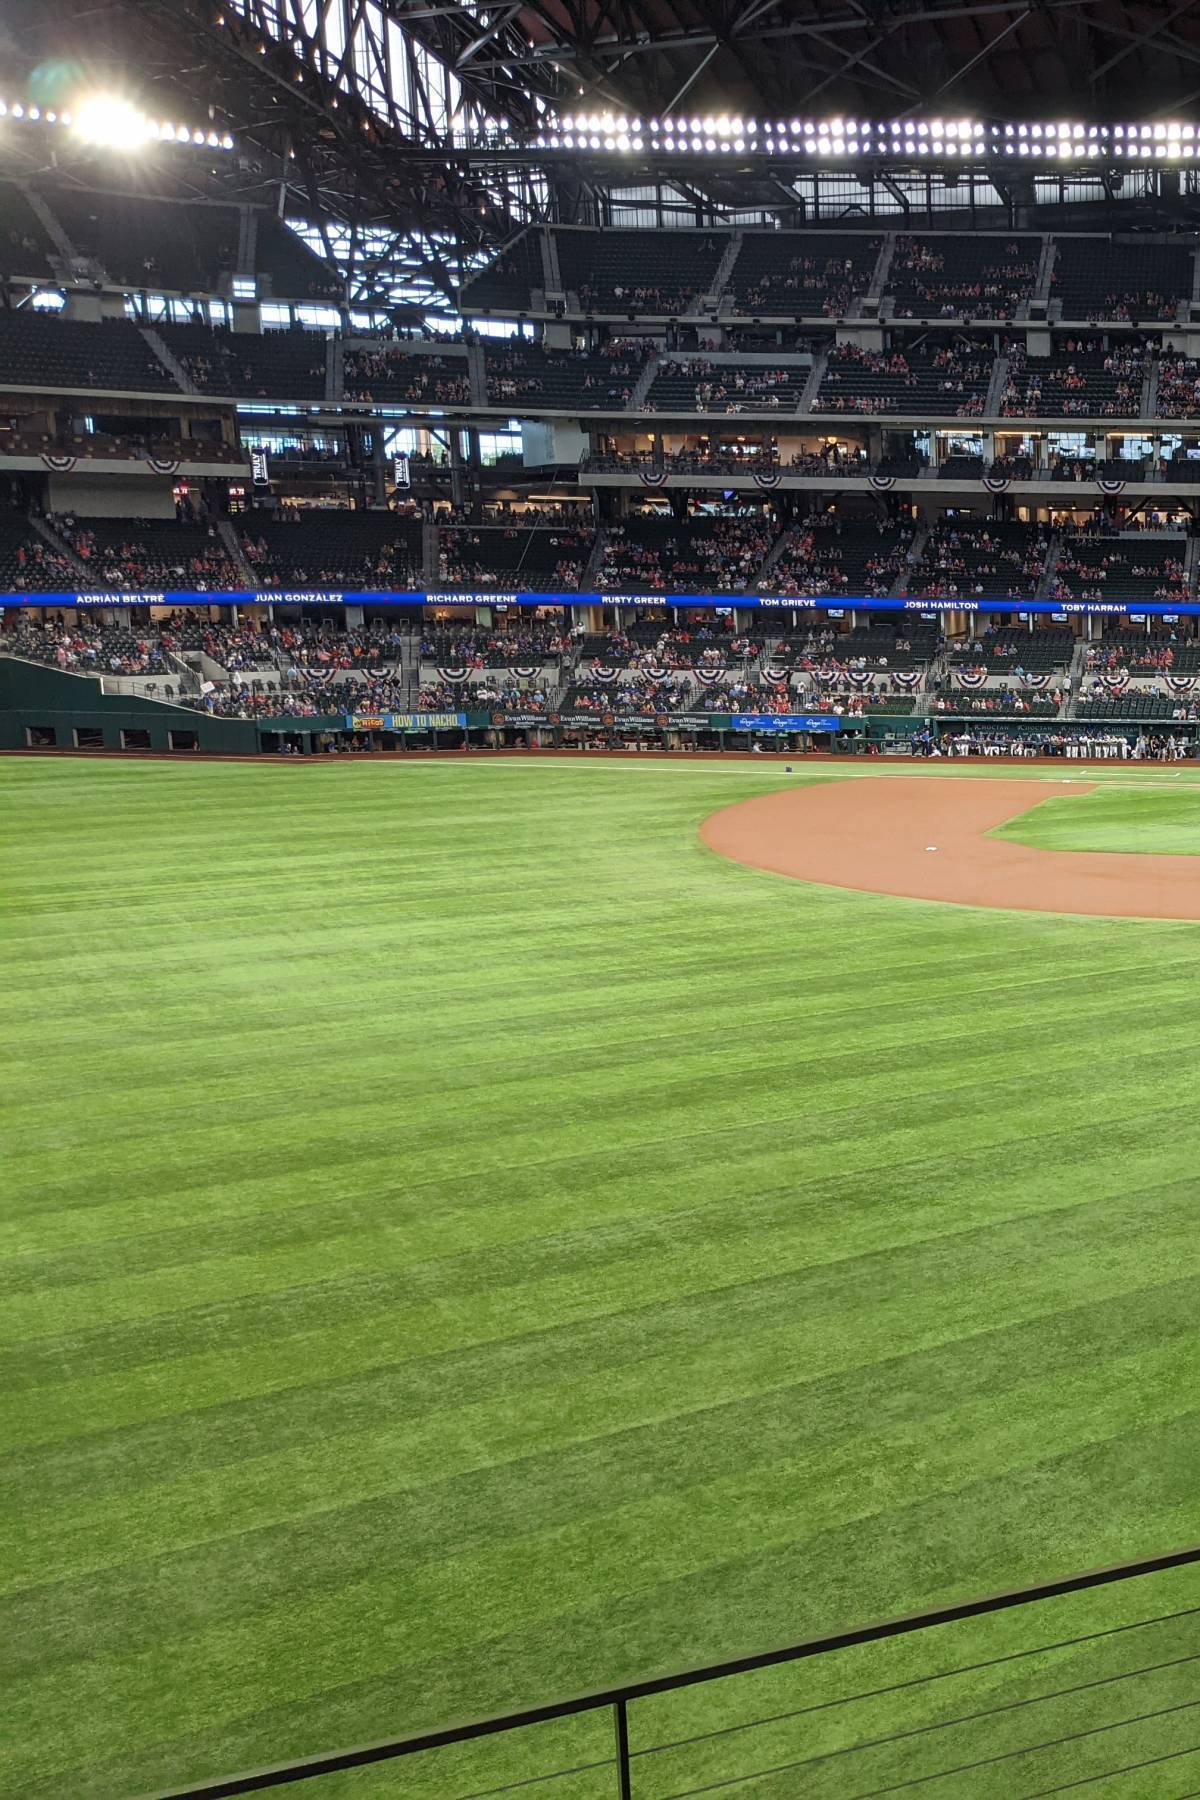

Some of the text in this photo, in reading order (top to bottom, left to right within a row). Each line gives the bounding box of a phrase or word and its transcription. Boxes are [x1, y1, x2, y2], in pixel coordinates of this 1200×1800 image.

[252, 453, 262, 479] TRULY
[394, 458, 403, 483] TRULY
[76, 594, 120, 604] ADRIÁN
[254, 594, 283, 602] JUAN
[426, 594, 517, 603] RICHARD GREENE
[601, 595, 667, 605] RUSTY GREER
[759, 598, 817, 608] TOM GRIEVE
[903, 600, 979, 610] JOSH HAMILTON
[1061, 603, 1127, 613] TOBY HARRAH
[392, 714, 461, 727] HOW TO NACHO.
